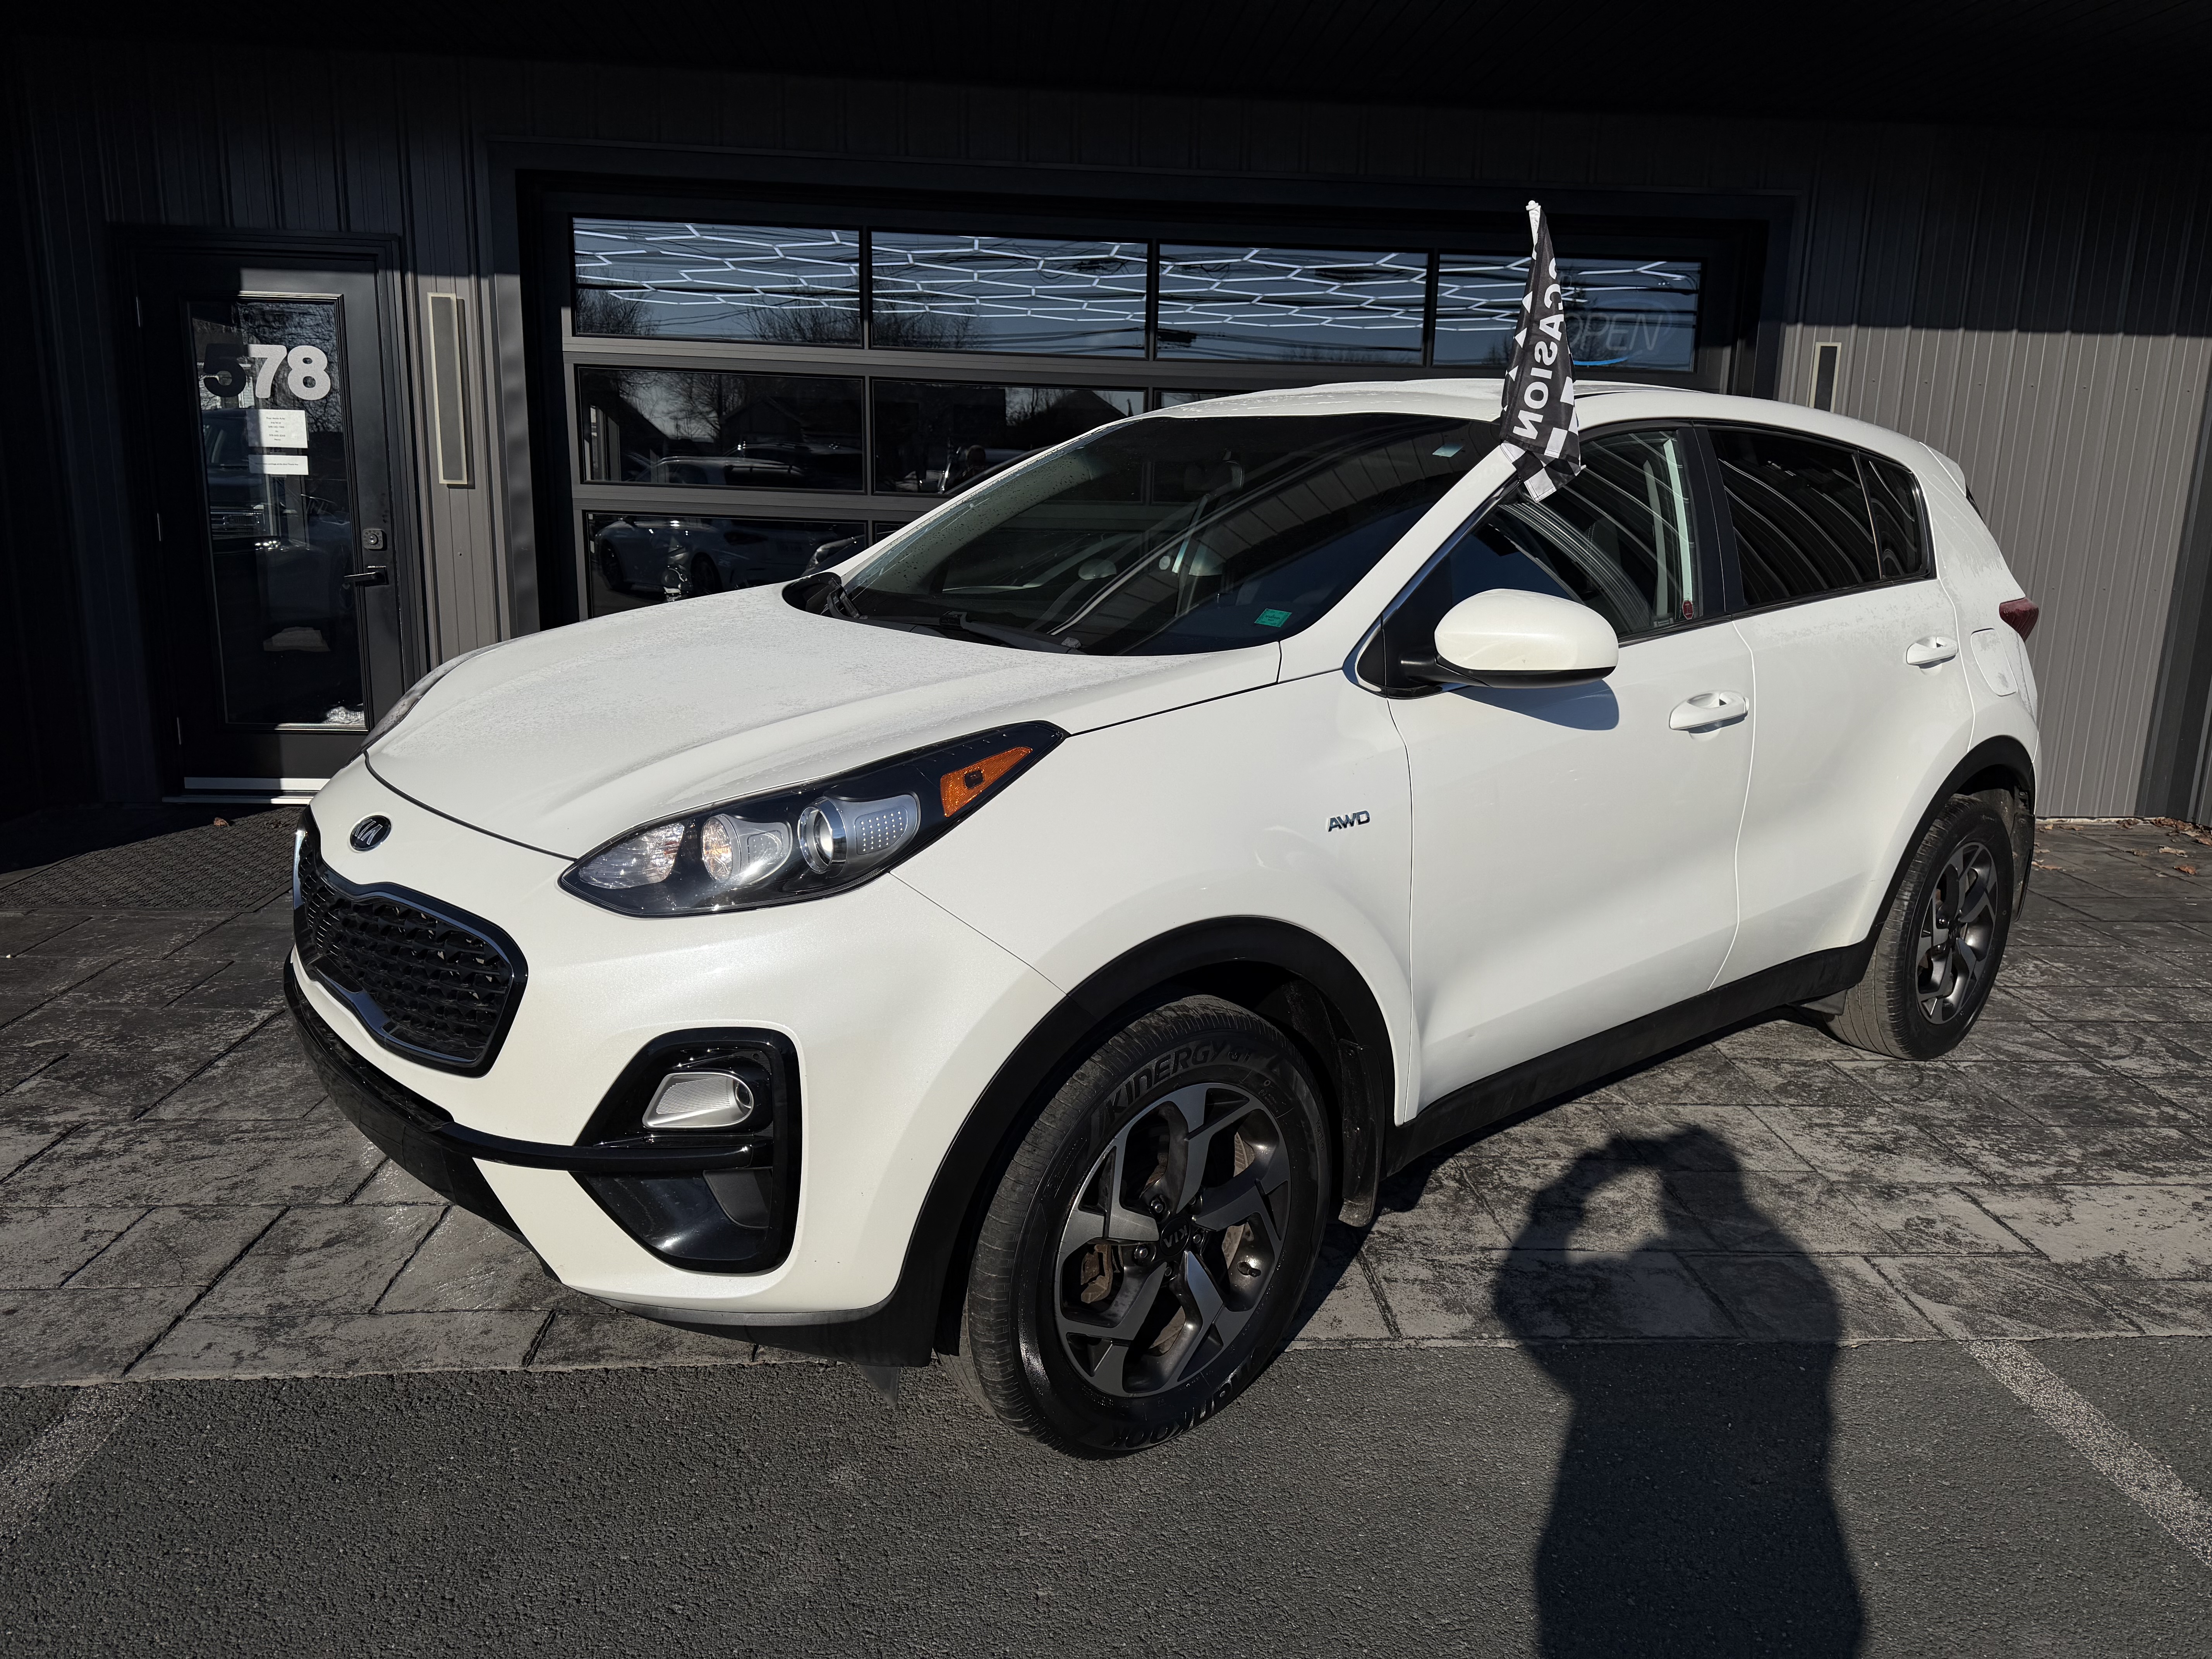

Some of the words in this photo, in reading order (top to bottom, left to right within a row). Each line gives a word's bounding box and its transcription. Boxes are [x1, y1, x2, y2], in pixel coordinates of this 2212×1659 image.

[204, 343, 331, 400] 578
[352, 819, 383, 845] KIA
[1328, 810, 1370, 832] AWD
[1106, 1040, 1227, 1123] KINERGY
[1162, 1224, 1188, 1249] KIA
